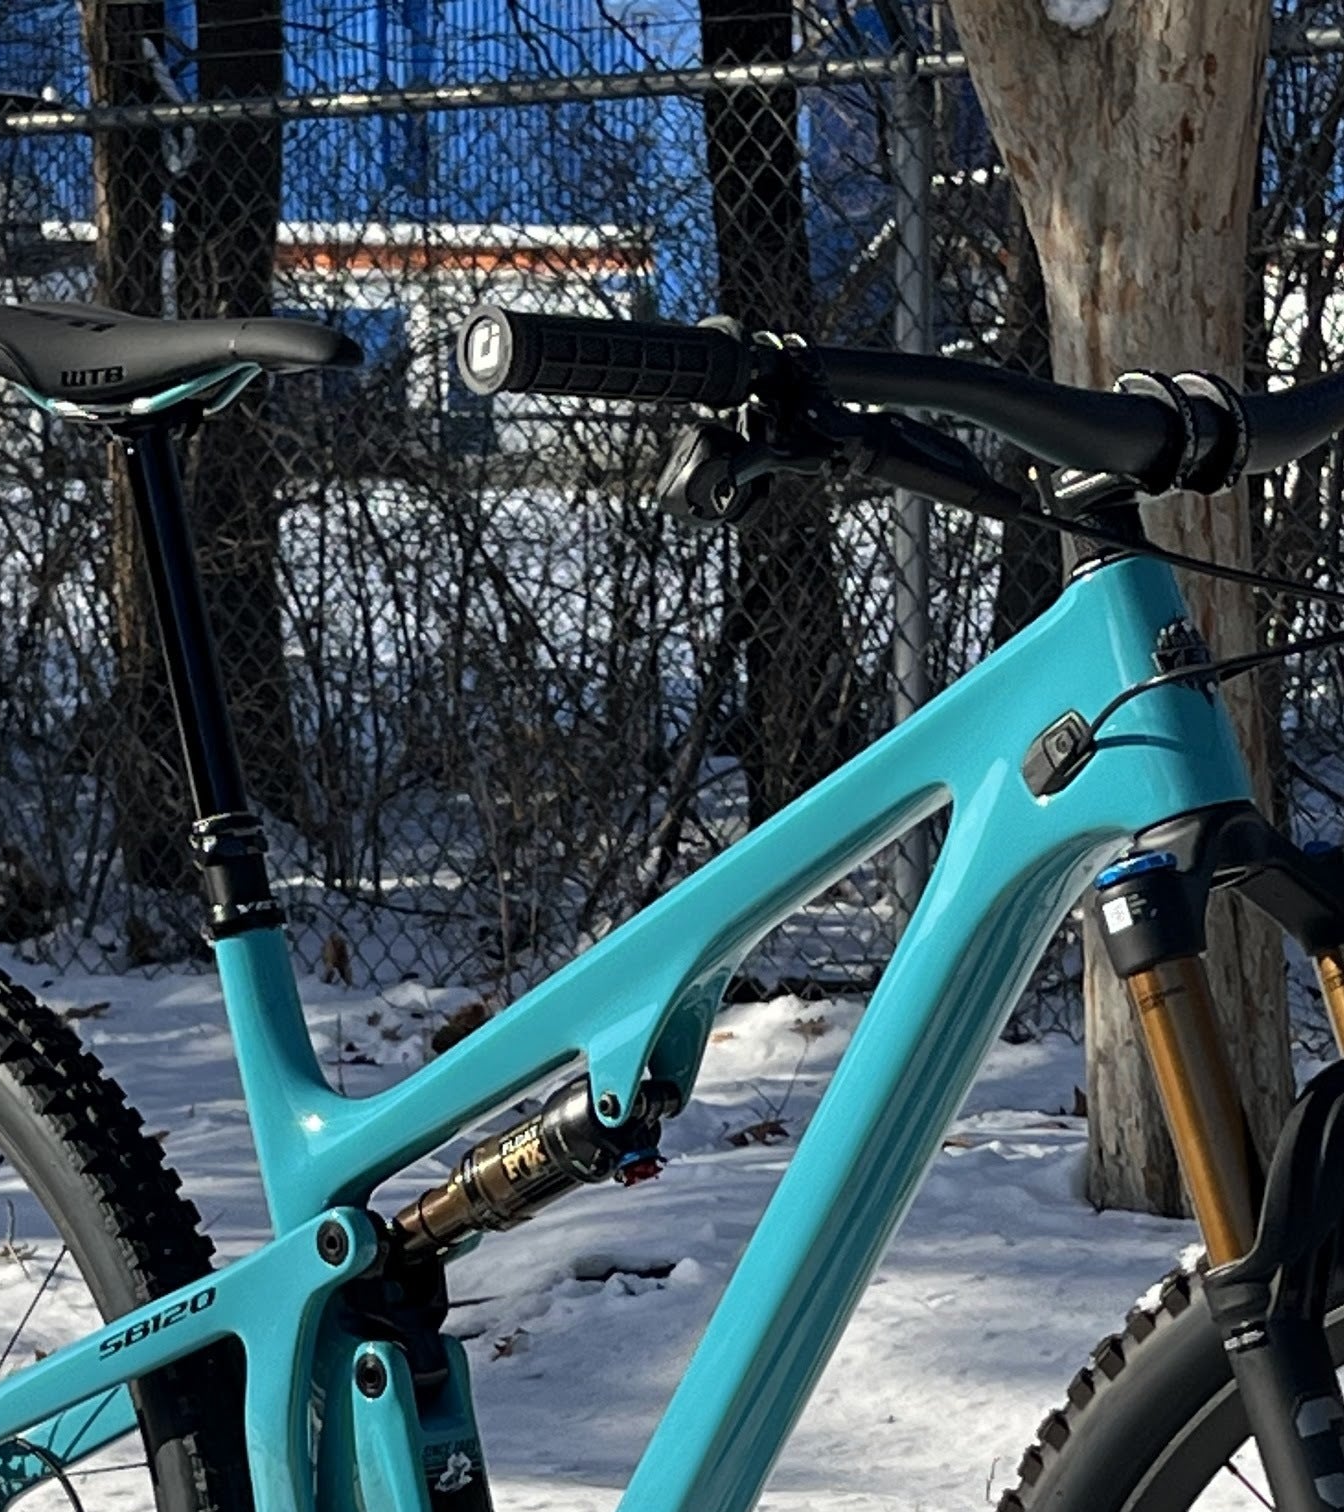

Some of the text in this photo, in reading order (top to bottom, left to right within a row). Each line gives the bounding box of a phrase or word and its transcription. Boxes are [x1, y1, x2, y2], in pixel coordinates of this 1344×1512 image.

[60, 366, 124, 387] WTB
[501, 1139, 549, 1182] FOX
[99, 1287, 216, 1361] SB120
